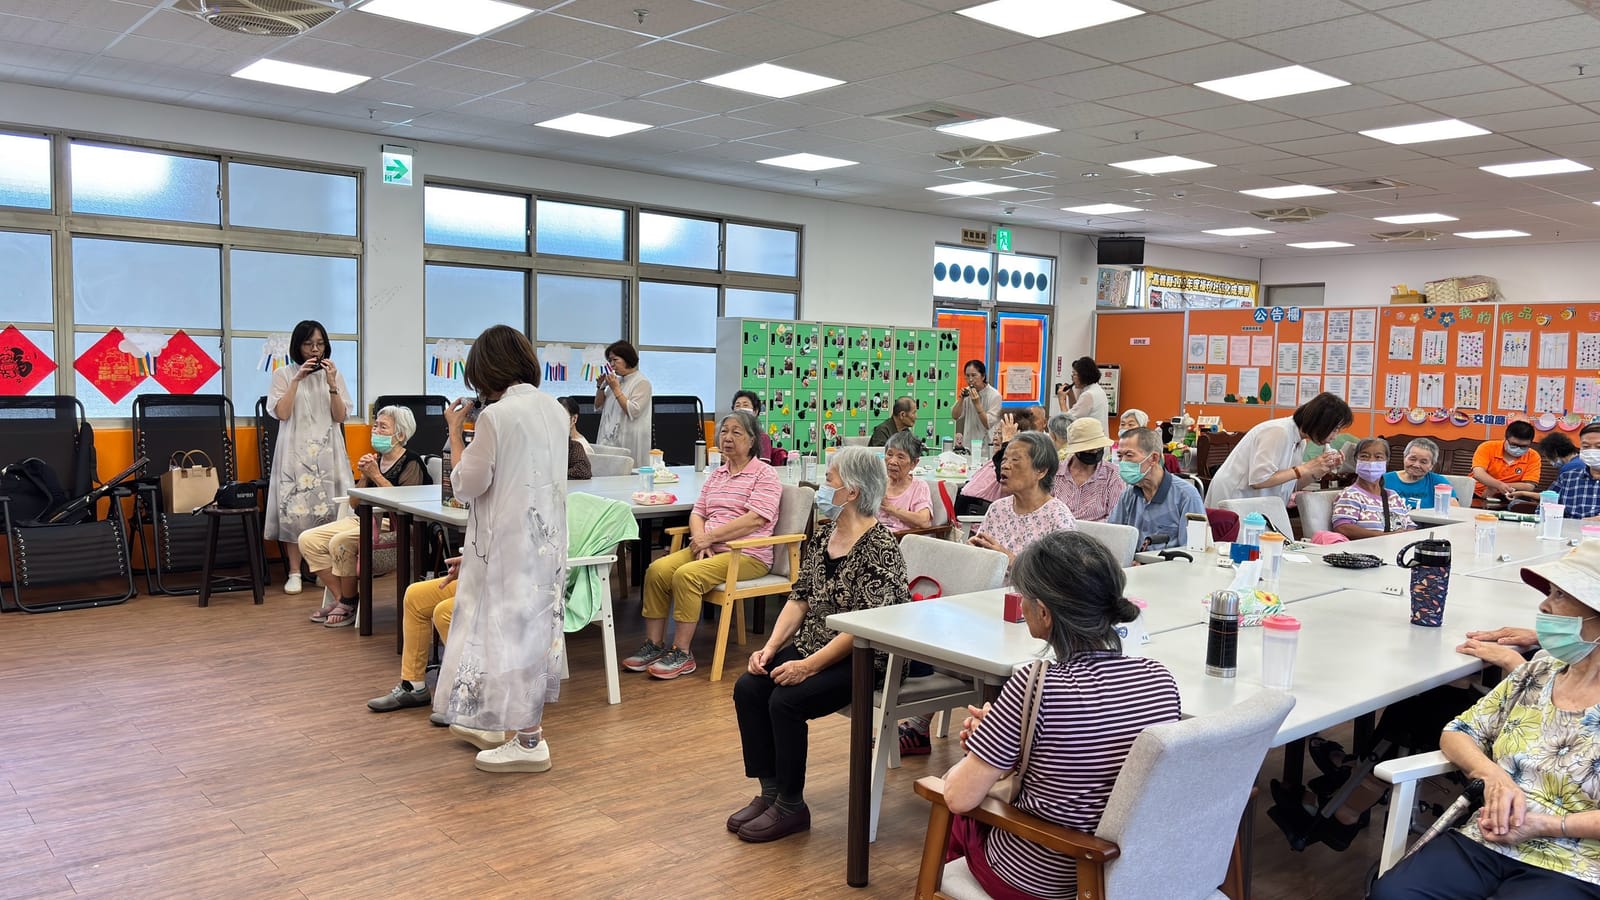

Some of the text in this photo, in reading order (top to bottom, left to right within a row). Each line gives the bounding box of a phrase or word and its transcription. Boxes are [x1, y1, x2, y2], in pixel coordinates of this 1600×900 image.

[1254, 307, 1300, 321] 公告欄
[1459, 306, 1532, 325] 我的作品
